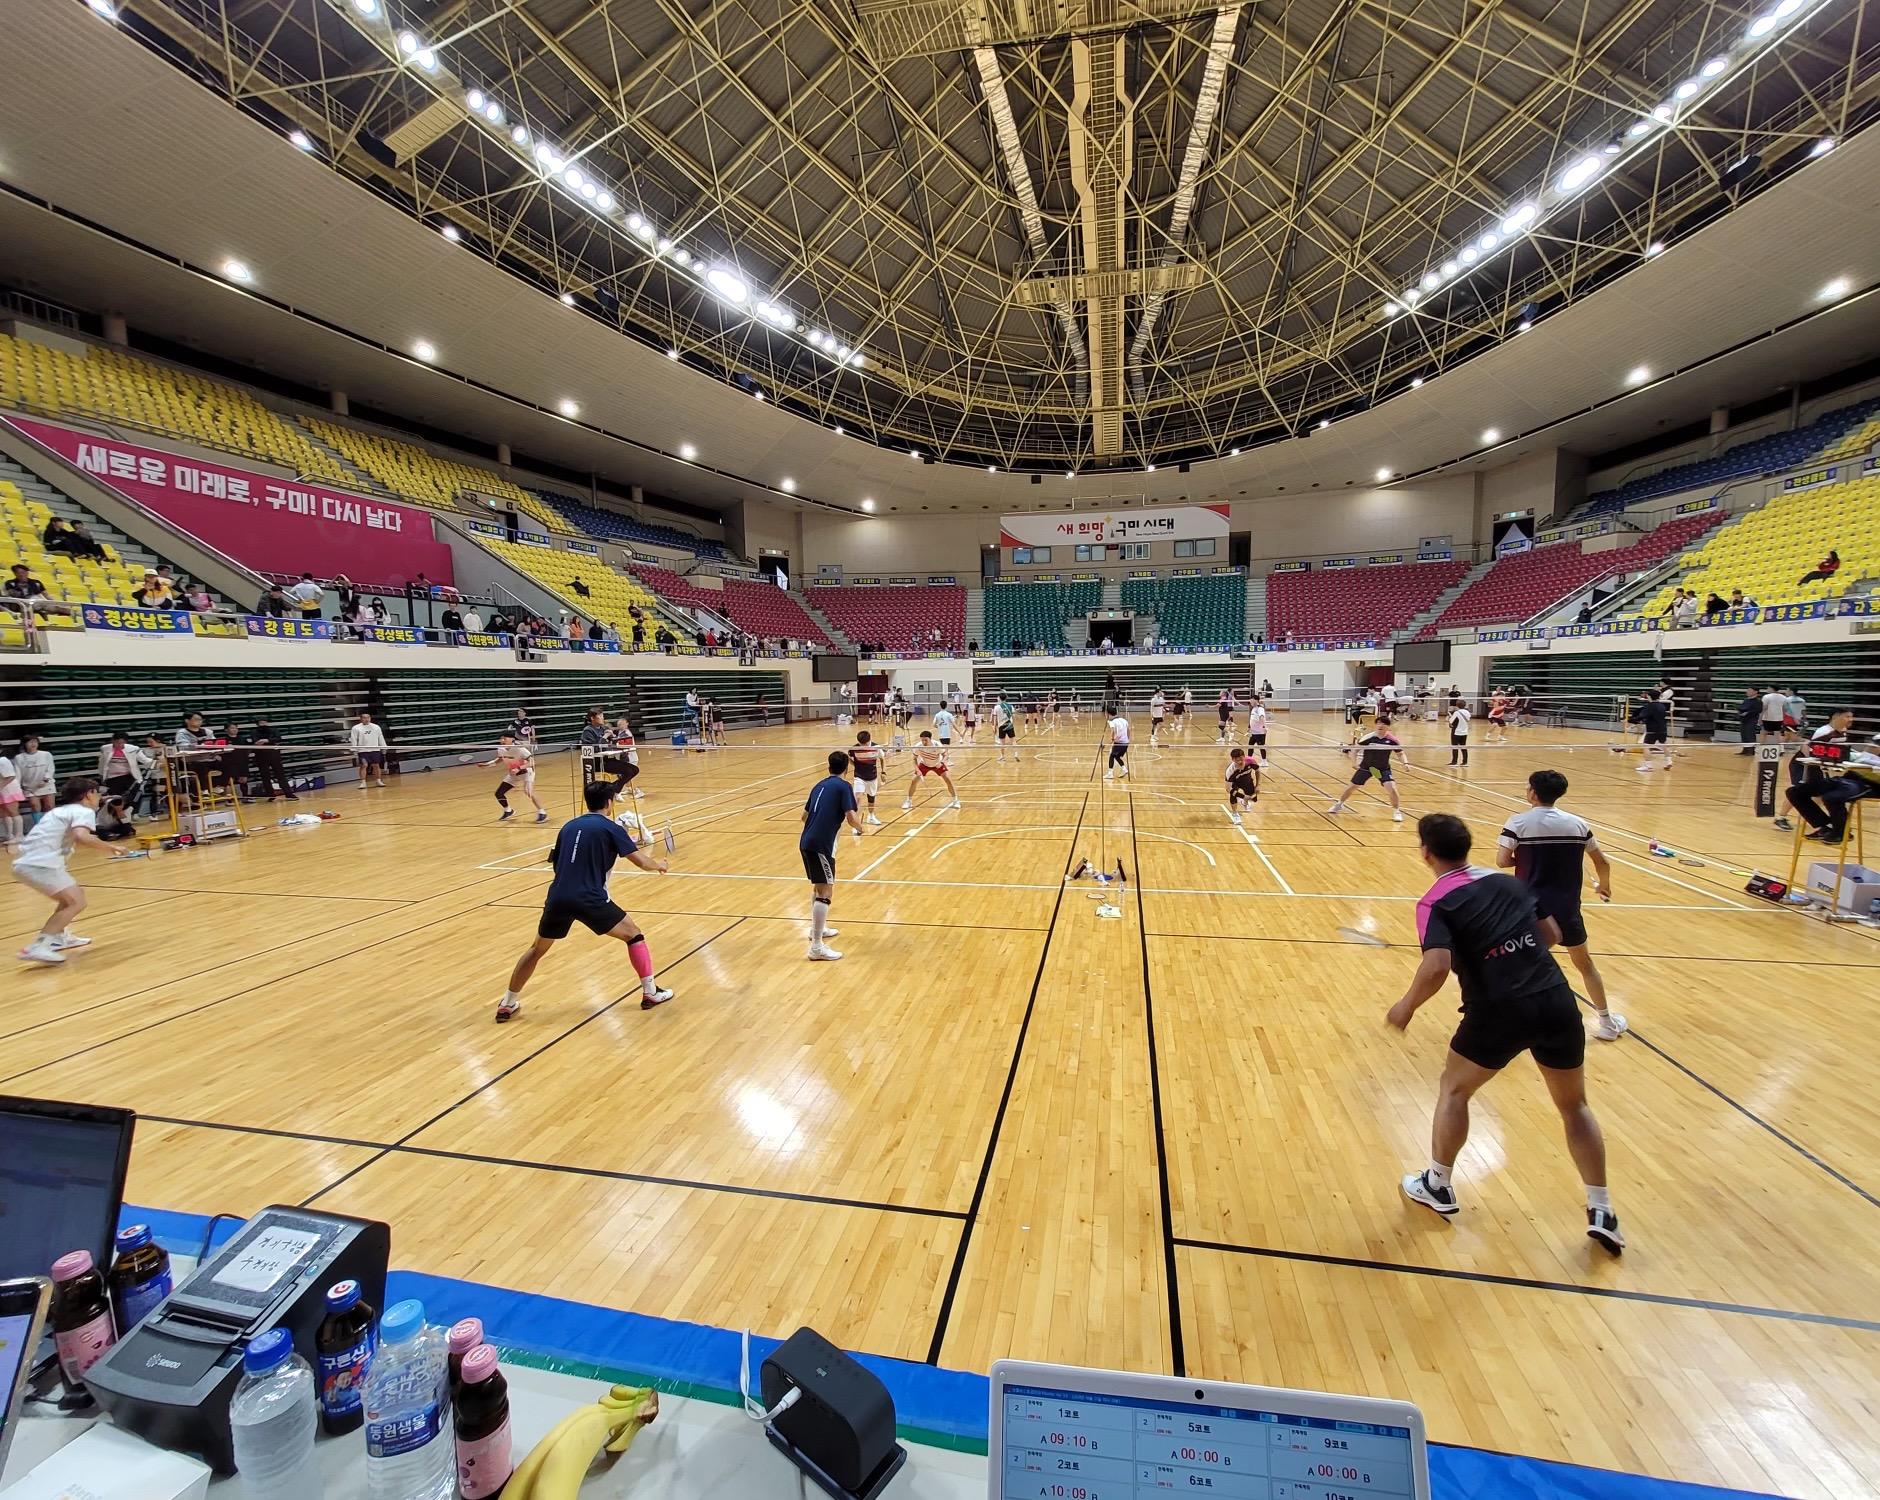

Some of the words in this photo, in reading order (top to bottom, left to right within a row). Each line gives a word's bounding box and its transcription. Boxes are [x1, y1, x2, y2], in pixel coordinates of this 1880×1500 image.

[77, 443, 167, 487] 새로운
[174, 465, 260, 507] 미래로,
[265, 484, 316, 516] 구미!
[322, 497, 361, 525] 다시
[365, 506, 402, 532] 날다
[1057, 524, 1074, 535] 새
[1078, 522, 1105, 541] 희망
[1115, 520, 1140, 537] 구미
[1143, 518, 1175, 530] 시대
[1711, 610, 1745, 625] 성주군
[1776, 604, 1814, 620] 청송군
[103, 609, 176, 631] 경상남도
[263, 619, 315, 637] 강원도
[374, 628, 416, 643] 경상북도
[466, 632, 500, 648] 인천광역시
[592, 641, 610, 651] 제주도
[583, 748, 592, 757] 02
[1762, 747, 1777, 760] 03
[1058, 1408, 1081, 1419] 1코트
[1188, 1422, 1212, 1434] 5코트
[1040, 1435, 1047, 1444] A
[1091, 1441, 1098, 1450] B
[1324, 1438, 1349, 1450] 9코트
[1057, 1459, 1080, 1471] 2코트
[1171, 1450, 1178, 1460] A
[1224, 1457, 1231, 1465] B
[1189, 1475, 1213, 1487] 6코트
[1307, 1467, 1315, 1477] A
[1363, 1474, 1371, 1483] B
[1040, 1487, 1047, 1497] A
